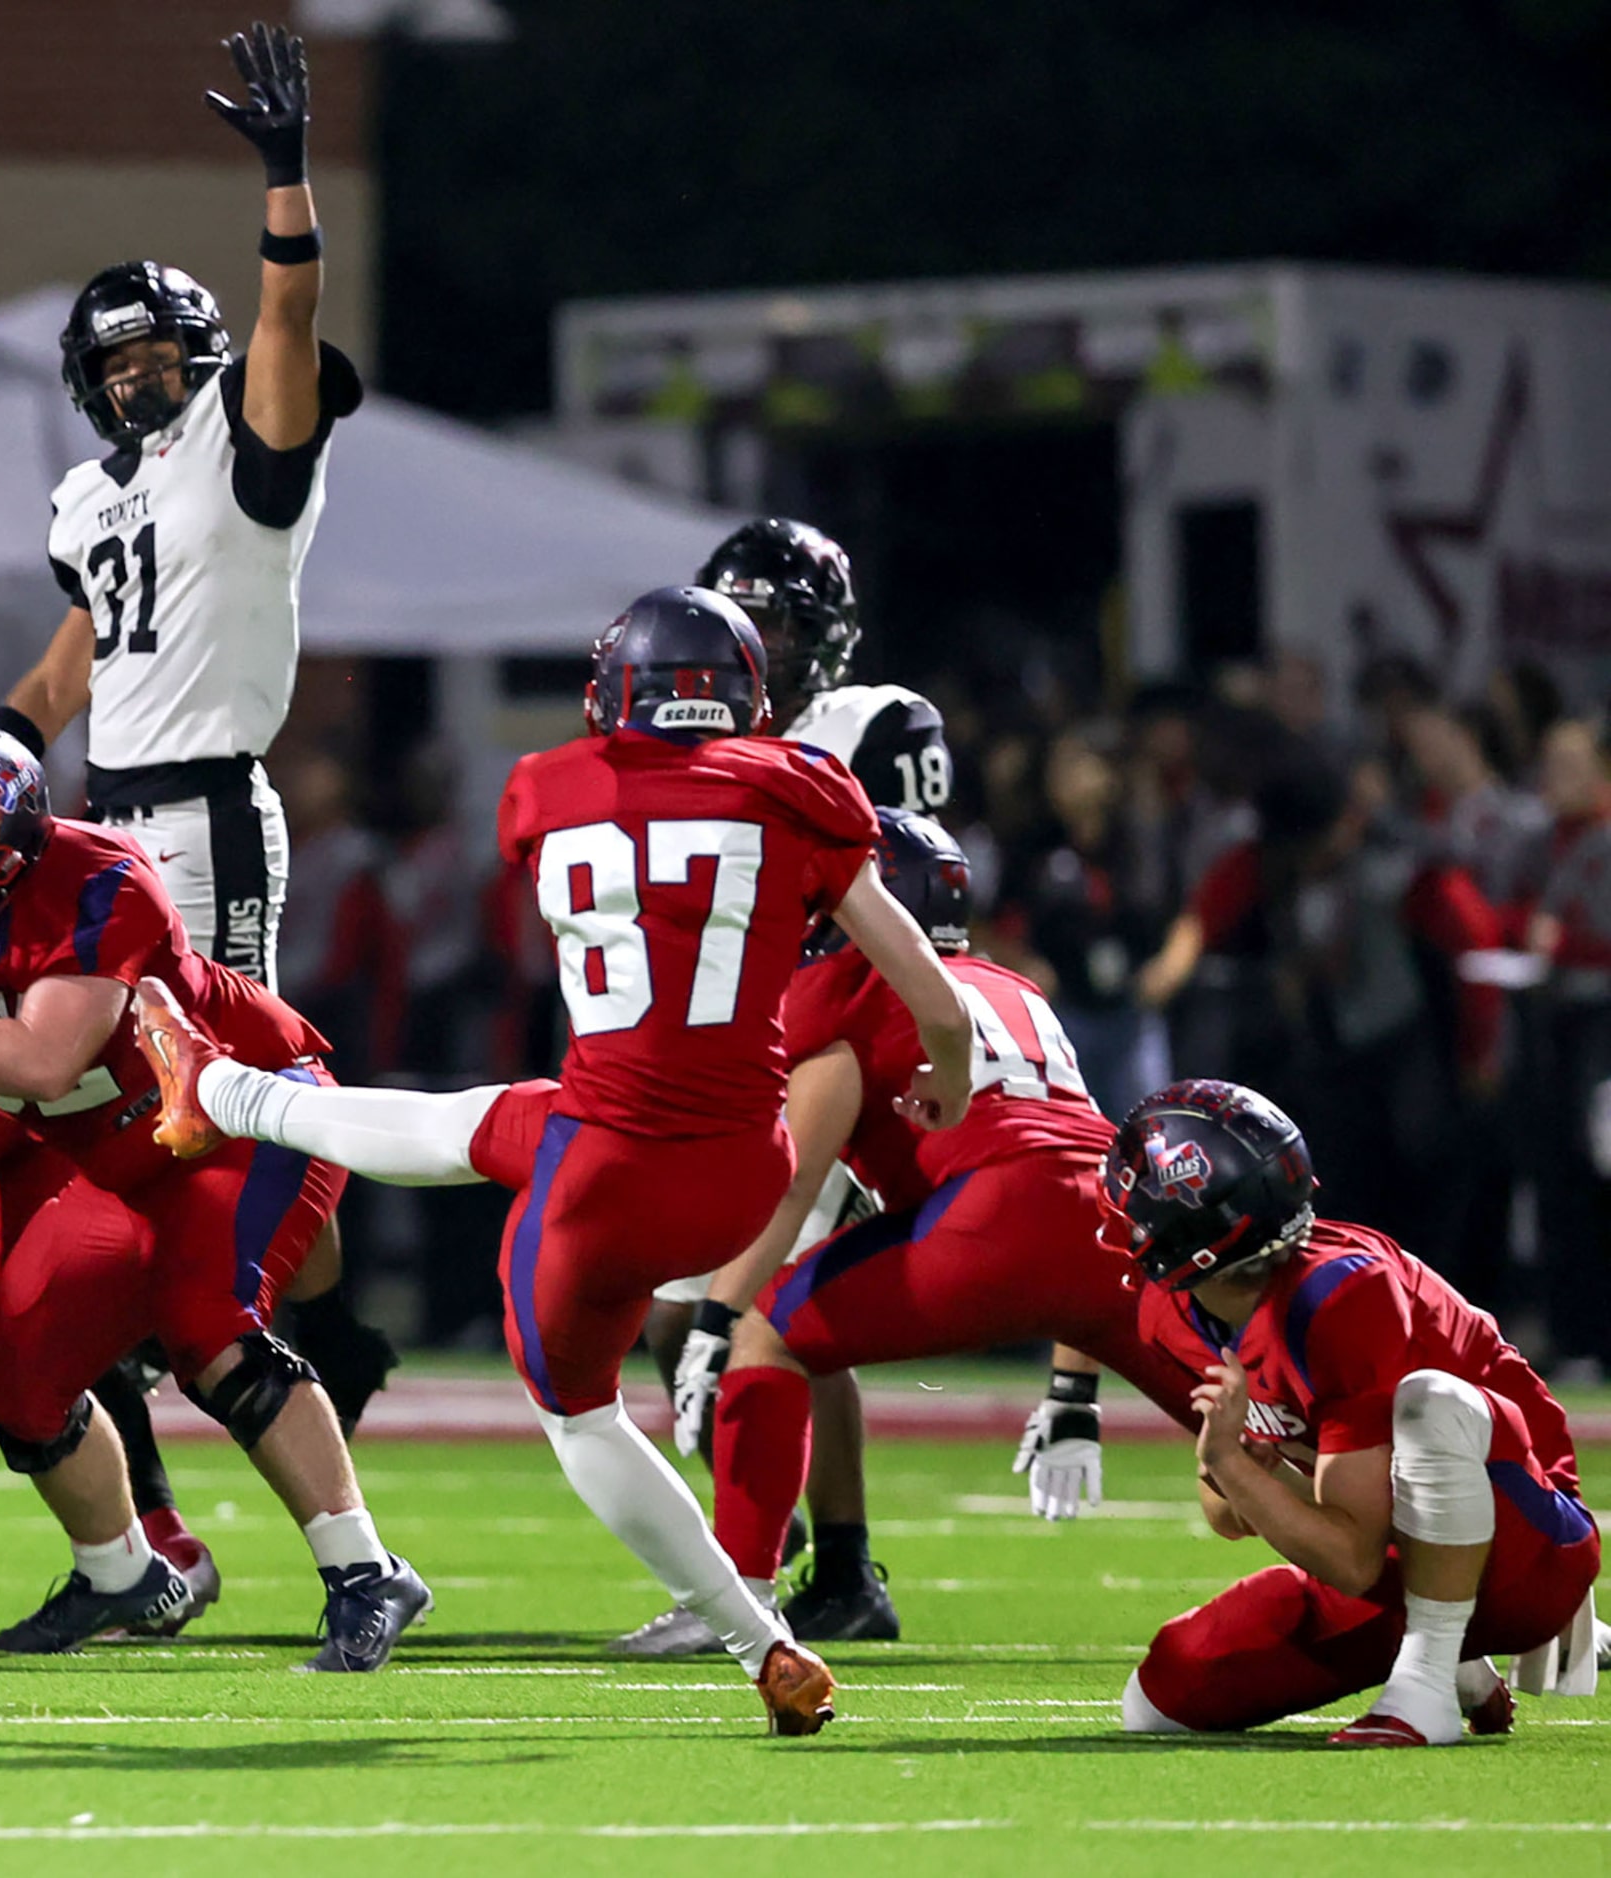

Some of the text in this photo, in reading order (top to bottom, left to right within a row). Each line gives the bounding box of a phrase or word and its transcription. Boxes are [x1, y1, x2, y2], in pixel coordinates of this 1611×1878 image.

[87, 521, 158, 661] 31
[664, 703, 725, 721] schutt
[894, 744, 950, 812] 18
[537, 820, 764, 1037] 87
[1158, 1155, 1202, 1182] TEXANS
